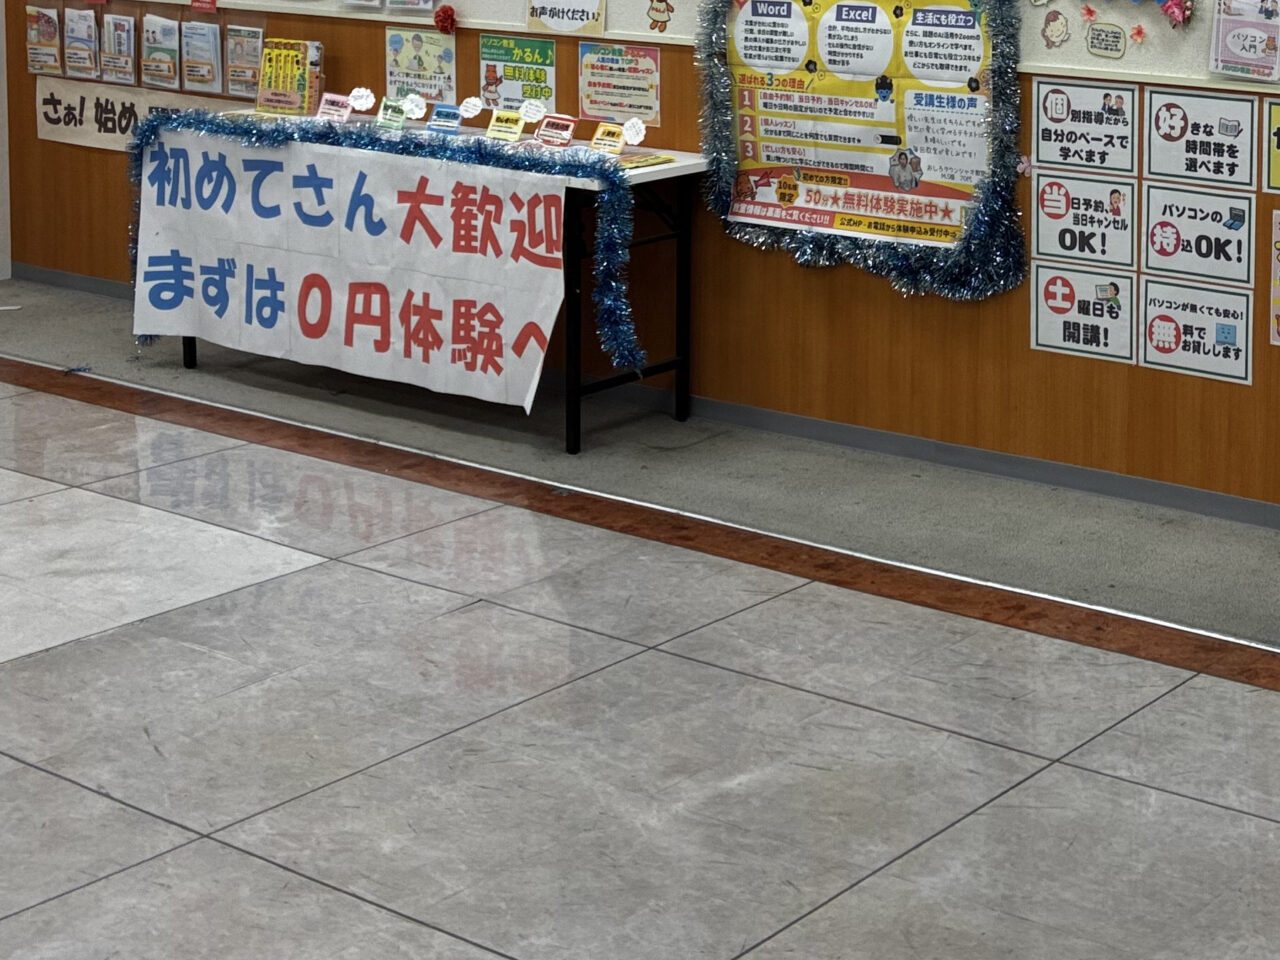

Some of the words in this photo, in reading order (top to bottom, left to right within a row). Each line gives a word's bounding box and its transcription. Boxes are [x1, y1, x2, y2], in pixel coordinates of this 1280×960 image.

[756, 2, 788, 16] Word
[841, 7, 873, 21] Excel
[915, 12, 974, 26] 生活にも役立つ
[1232, 32, 1266, 44] パソコン
[512, 47, 544, 64] かるん
[1240, 44, 1257, 54] 入門
[503, 63, 547, 84] 無料体験
[738, 72, 806, 89] 選ばれる3つの理由
[521, 83, 553, 101] 受付中
[913, 92, 978, 110] 受講生様の声
[42, 92, 86, 128] さぁ!
[743, 116, 752, 131] 2
[1155, 102, 1214, 142] 好きな
[1041, 128, 1129, 148] 自分のペースで
[744, 142, 753, 157] 3
[1059, 146, 1109, 165] 学べます
[1184, 139, 1239, 159] 時間帯を
[1184, 157, 1239, 177] 選べます
[147, 142, 564, 271] 初めてさん大歓迎
[779, 192, 795, 204] 限定
[1071, 212, 1129, 232] 当日キャンセル
[1161, 203, 1223, 224] パソコンの
[1058, 228, 1108, 256] OK!
[1043, 275, 1121, 319] 土曜日も
[142, 249, 548, 376] まずは0円体験へ
[1148, 298, 1244, 321] パソコンが無くても安心!
[1062, 321, 1110, 349] 開講!
[1148, 313, 1207, 354] 無料で
[1181, 339, 1243, 361] お貸しします
